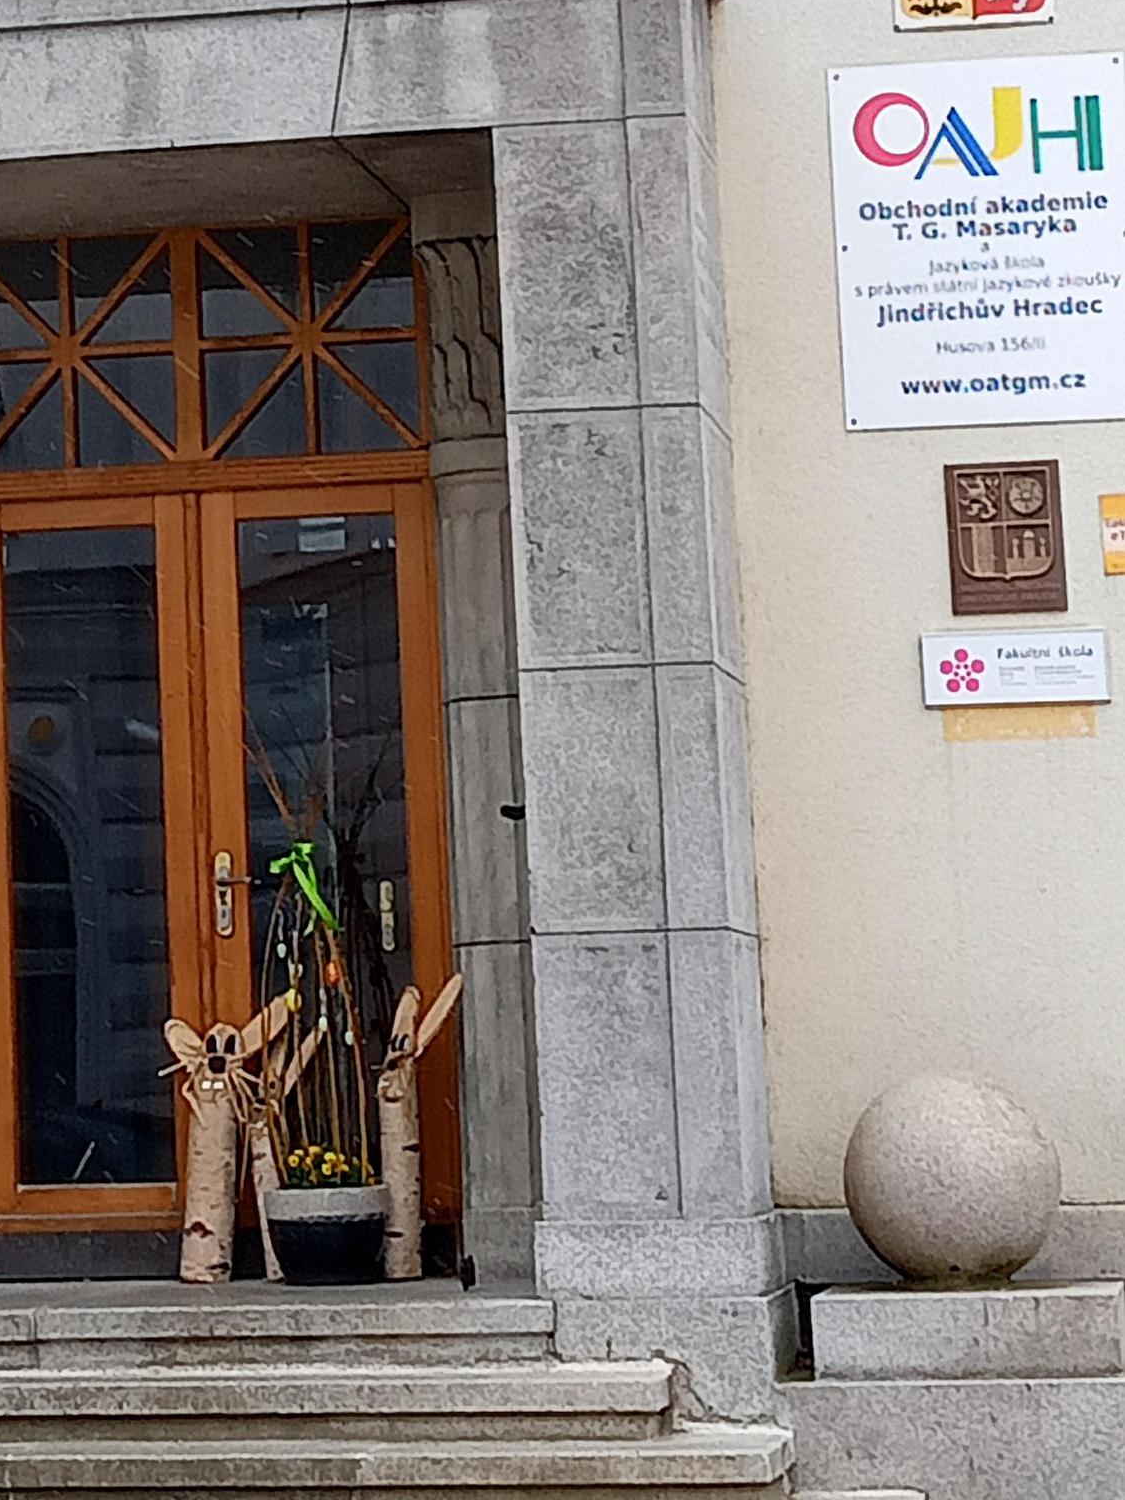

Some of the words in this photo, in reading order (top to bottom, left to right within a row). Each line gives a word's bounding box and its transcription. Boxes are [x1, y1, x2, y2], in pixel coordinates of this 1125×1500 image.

[859, 196, 978, 220] Obchodní
[986, 191, 1108, 214] akademie
[892, 223, 913, 241] T.
[921, 221, 947, 240] G.
[956, 215, 1078, 238] Masaryka
[980, 241, 991, 253] a
[854, 285, 863, 297] s
[868, 282, 928, 299] právem
[933, 280, 978, 293] státní
[1057, 272, 1121, 288] zkoušky
[877, 299, 1005, 327] Jindřichův
[1013, 296, 1103, 317] Hradec
[936, 340, 996, 355] Husova
[901, 373, 1087, 395] www.oatgm.cz
